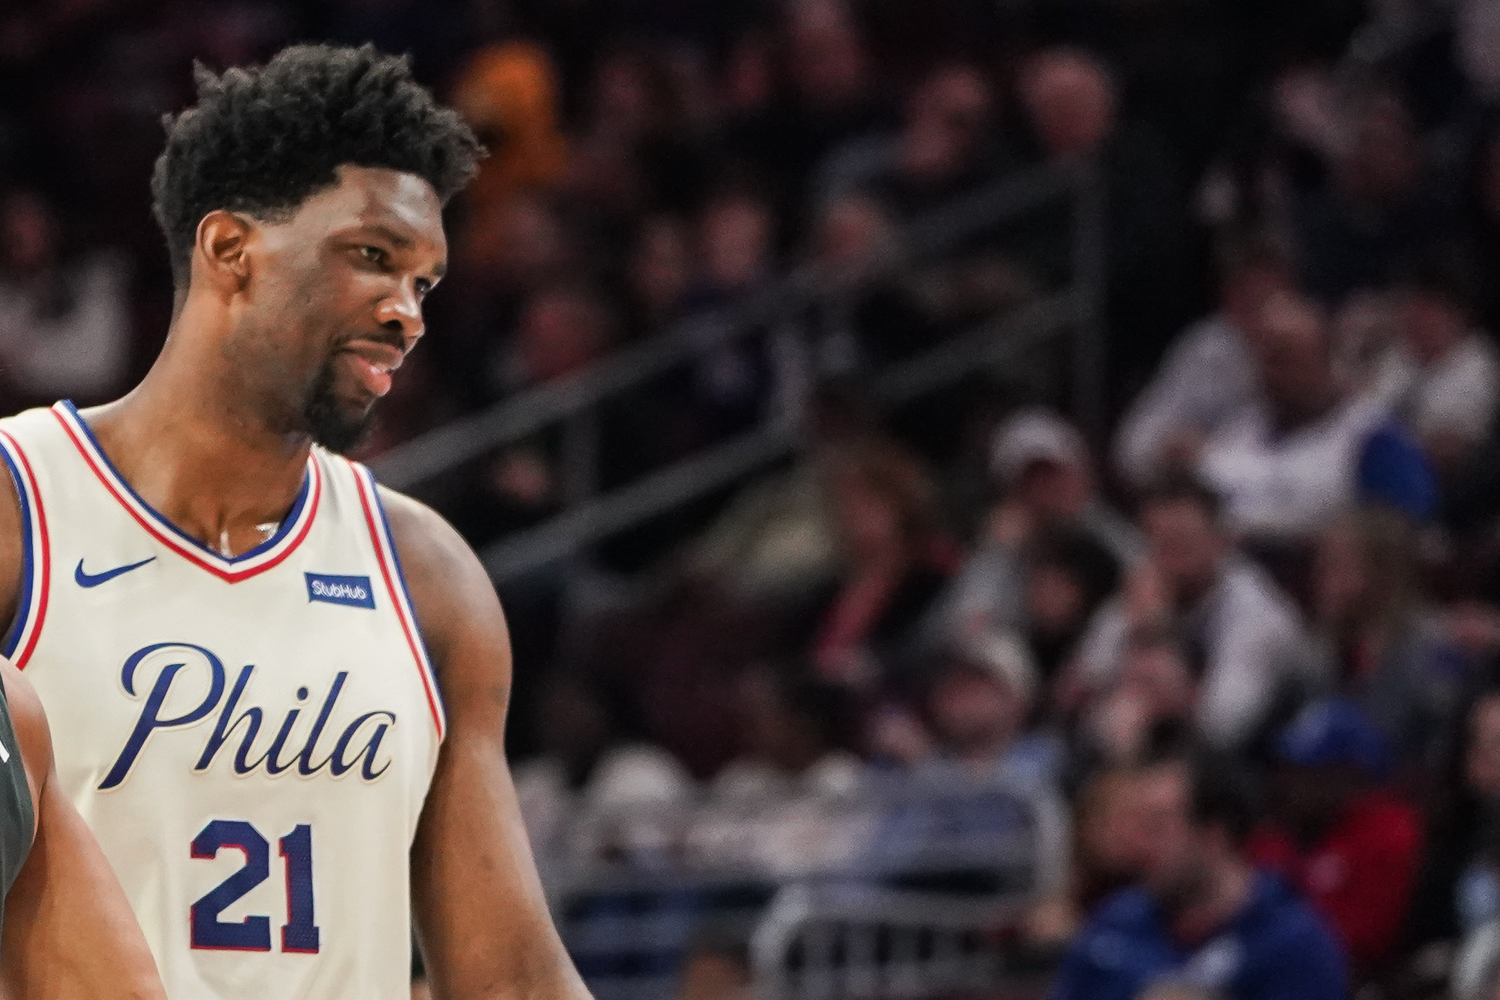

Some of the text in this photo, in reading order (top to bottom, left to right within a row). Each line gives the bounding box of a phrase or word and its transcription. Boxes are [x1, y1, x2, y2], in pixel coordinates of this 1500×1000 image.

[311, 580, 367, 599] StubHub
[97, 642, 396, 791] Phila
[190, 819, 320, 954] 21
